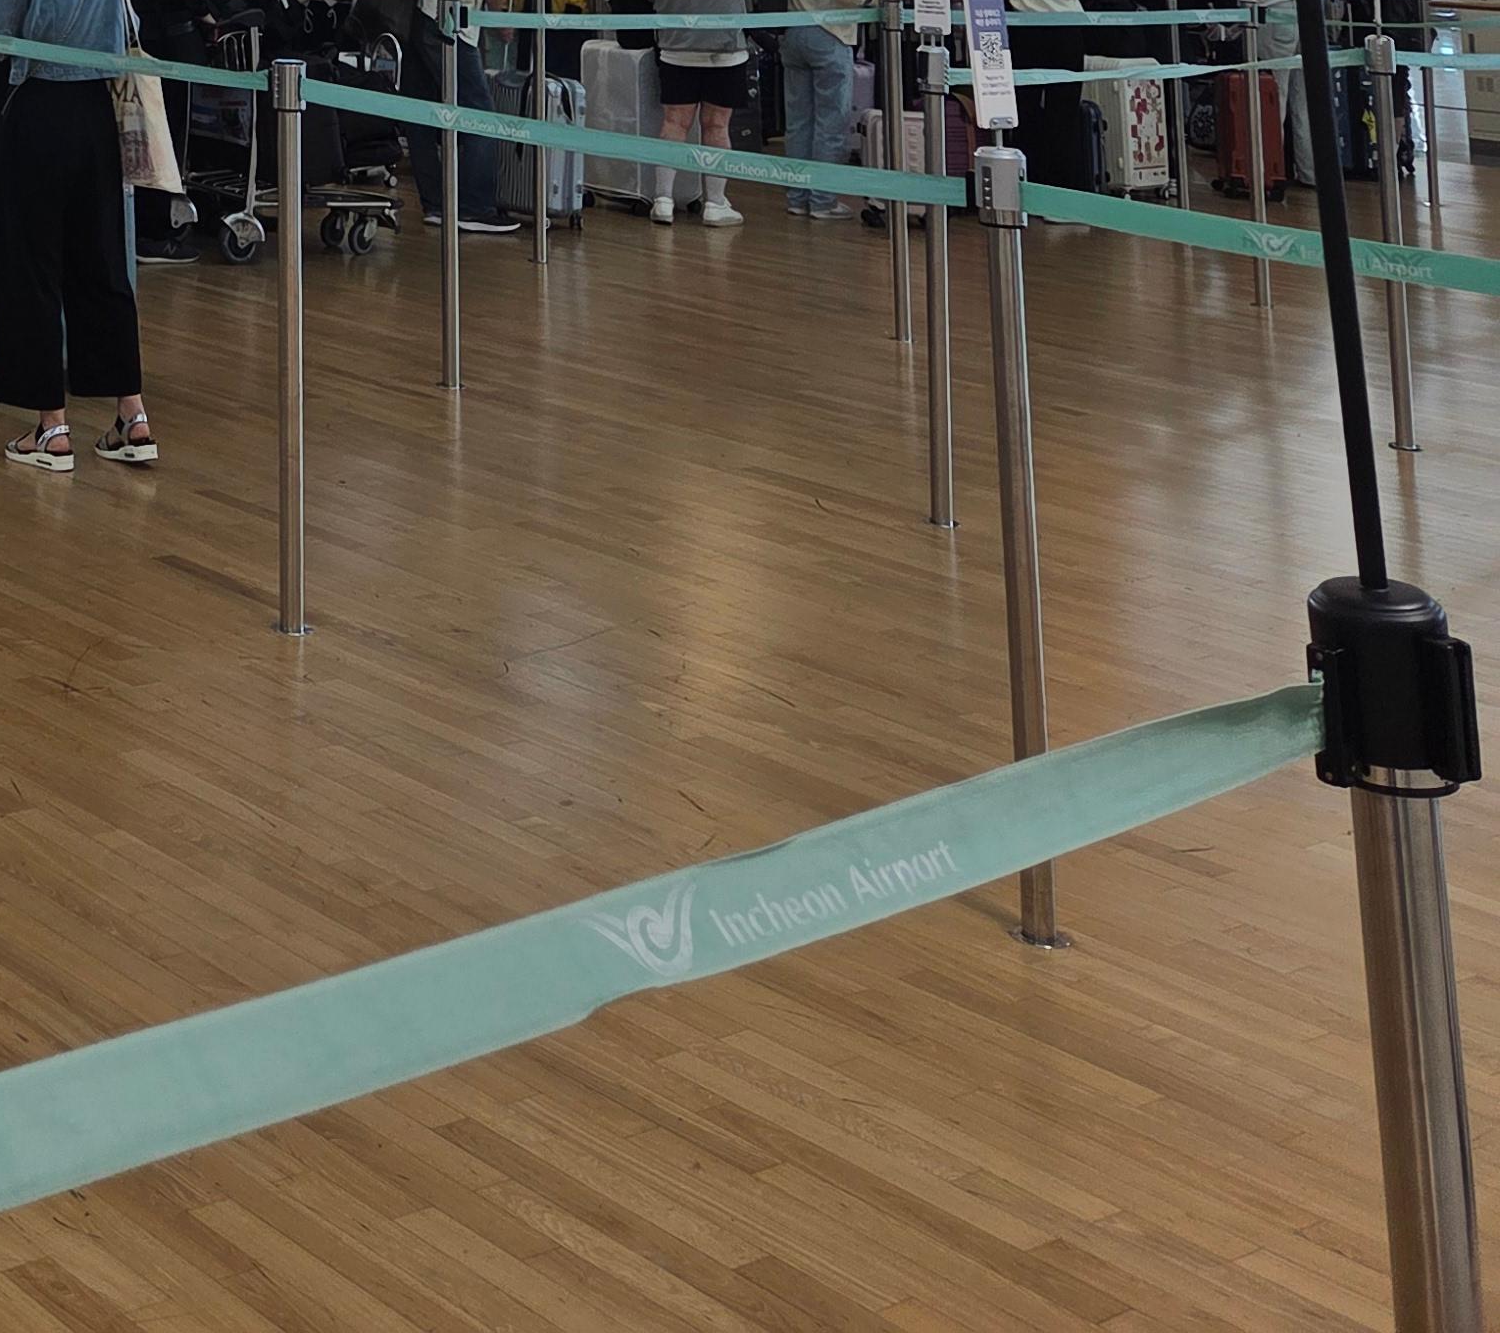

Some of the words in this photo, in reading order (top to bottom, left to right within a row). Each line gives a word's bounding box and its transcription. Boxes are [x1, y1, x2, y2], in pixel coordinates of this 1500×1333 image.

[724, 161, 769, 178] Incheon
[770, 168, 812, 184] Airport
[1371, 256, 1433, 279] Airport
[707, 881, 848, 949] Incheon
[850, 839, 956, 903] Airport
